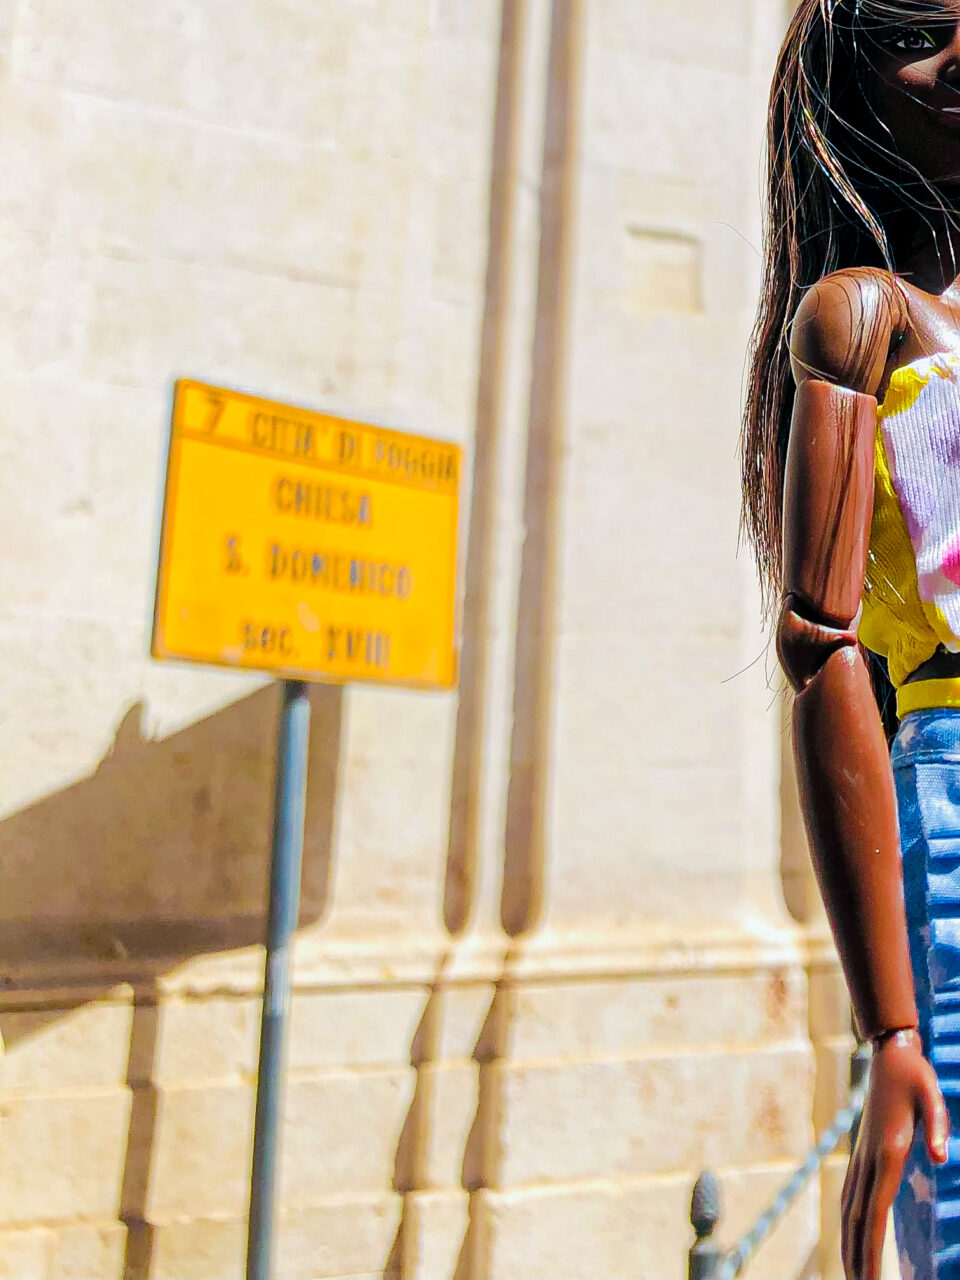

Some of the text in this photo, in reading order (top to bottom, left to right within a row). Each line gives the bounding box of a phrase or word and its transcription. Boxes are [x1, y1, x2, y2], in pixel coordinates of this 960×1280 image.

[338, 430, 361, 467] DI
[273, 476, 373, 526] CHIESA
[224, 534, 414, 602] S. DOMENICO
[325, 625, 391, 669] XVIII
